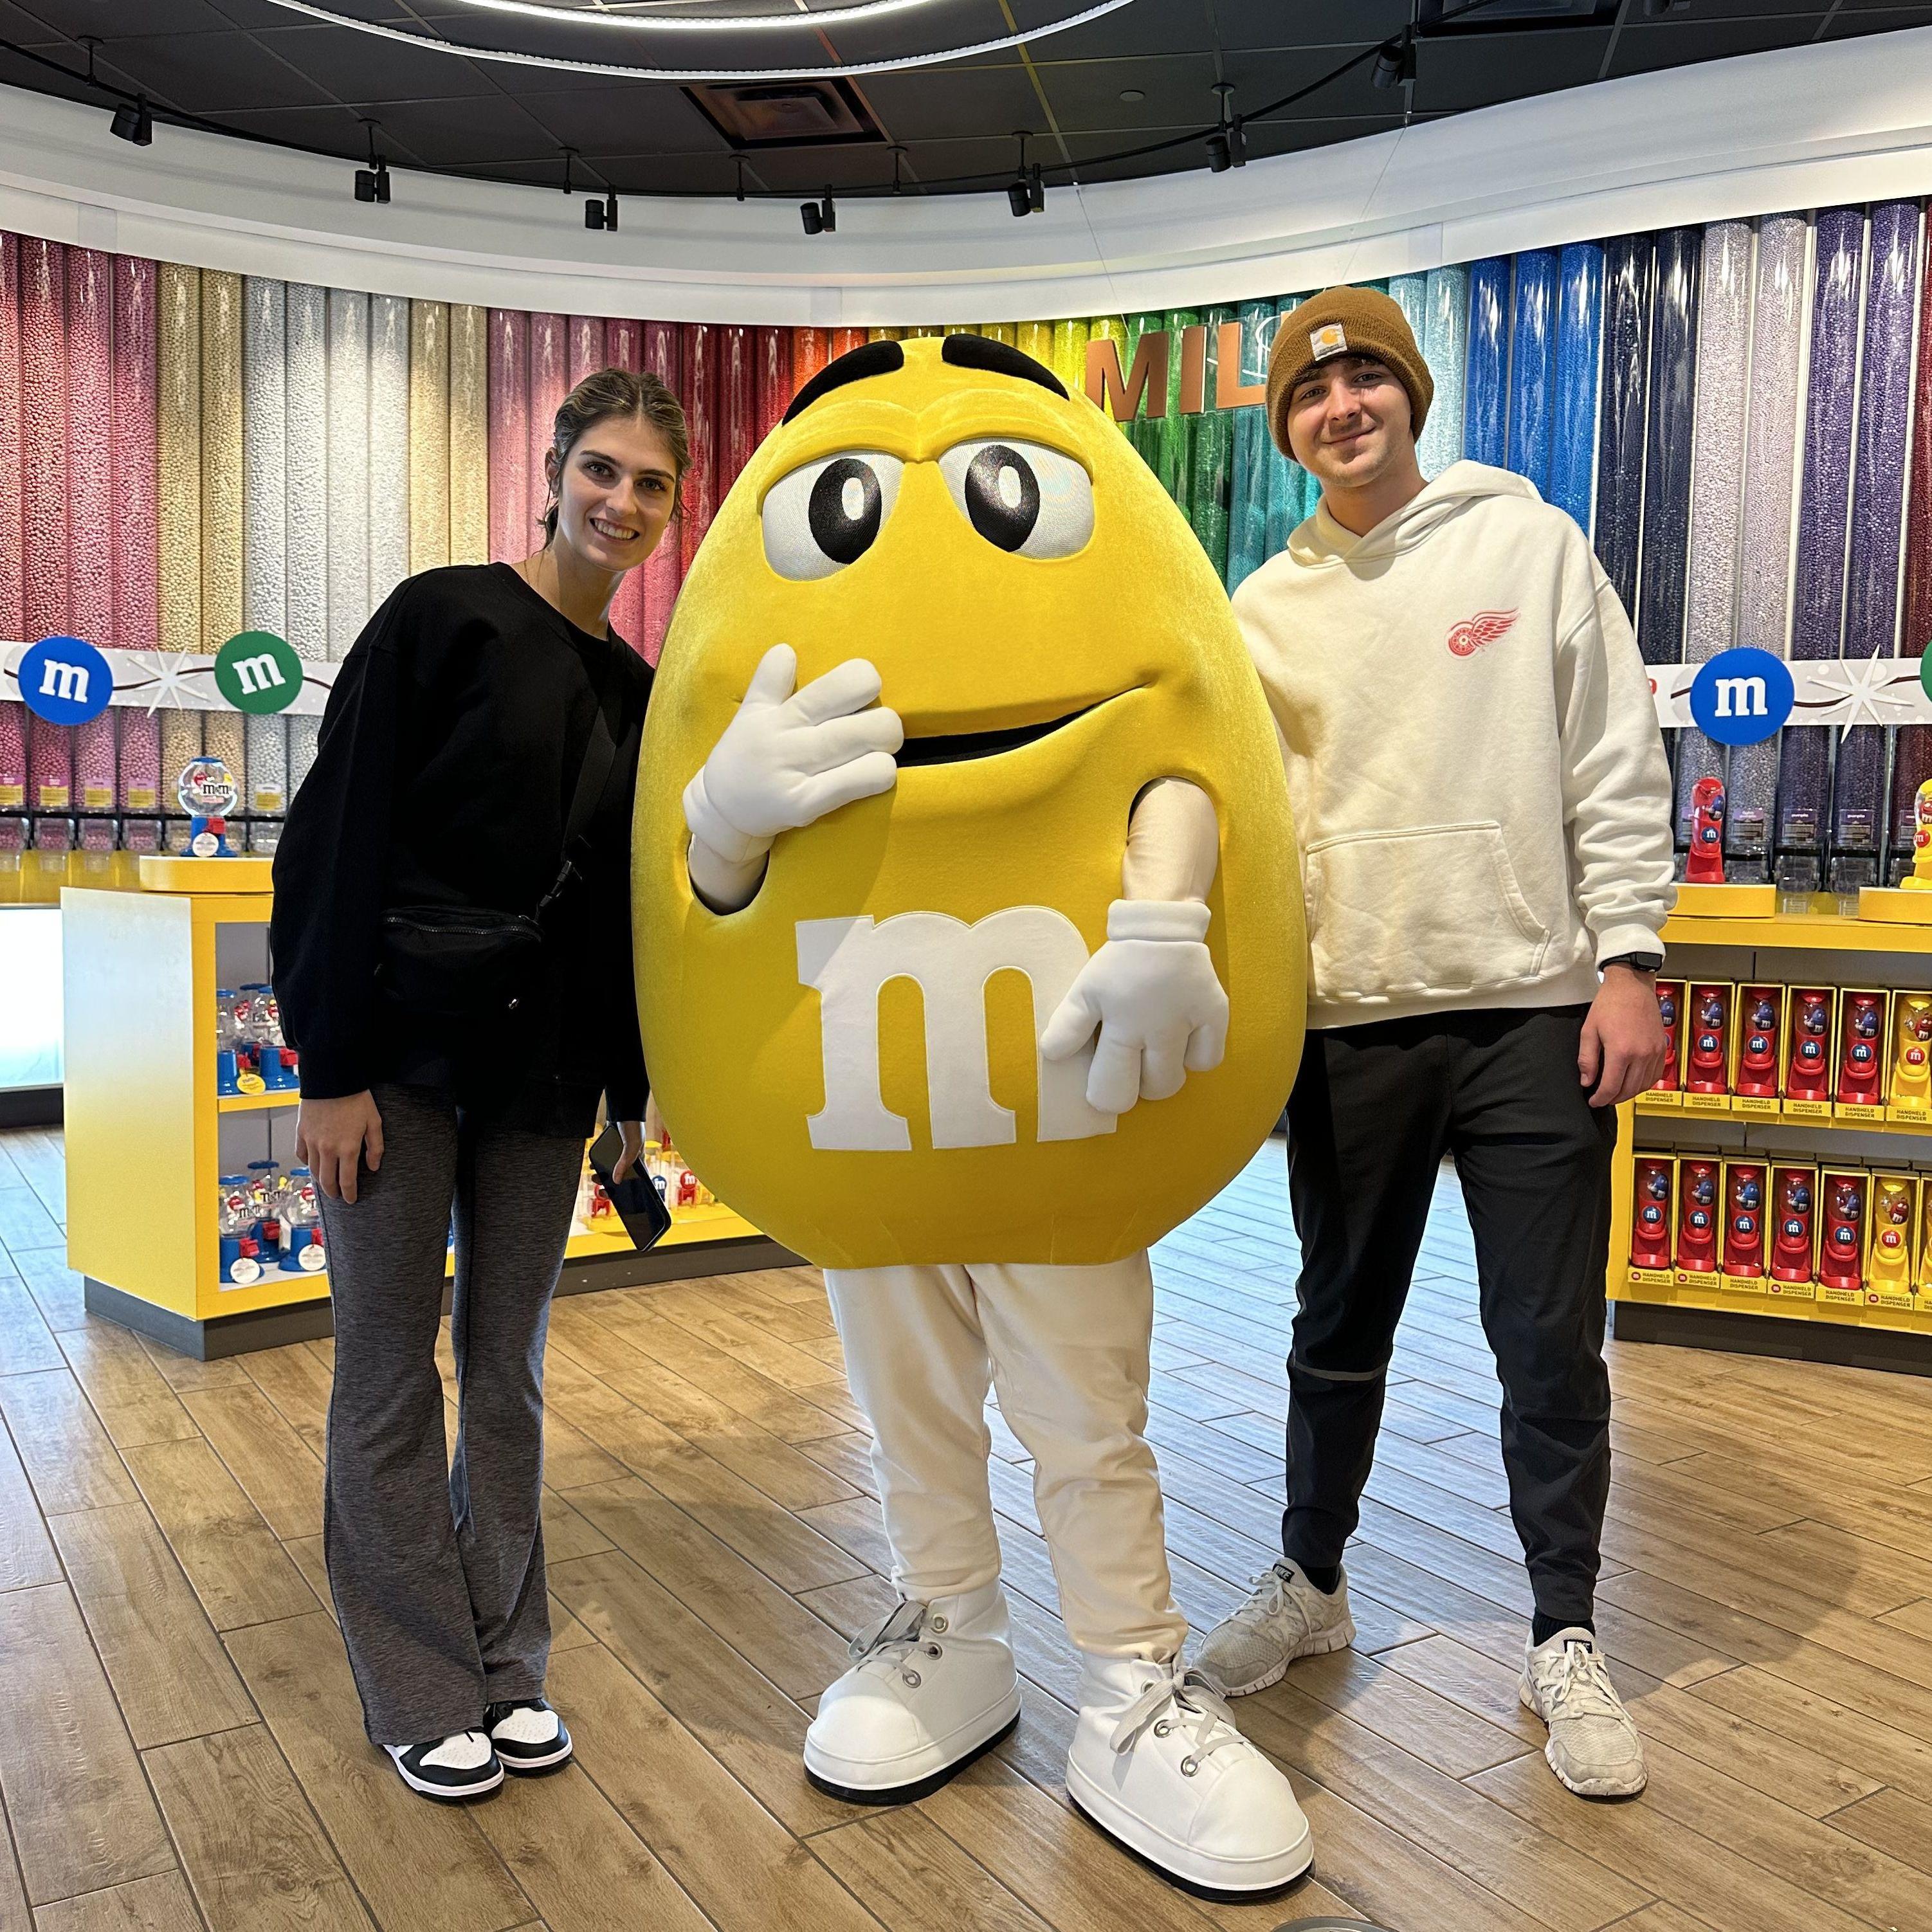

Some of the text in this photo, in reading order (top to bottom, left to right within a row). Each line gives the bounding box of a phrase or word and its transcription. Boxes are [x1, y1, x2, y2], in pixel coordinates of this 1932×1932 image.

[1086, 315, 1280, 422] MIL
[39, 659, 89, 703] m
[232, 653, 286, 695] m
[1714, 676, 1769, 718] m
[796, 906, 1118, 1152] m
